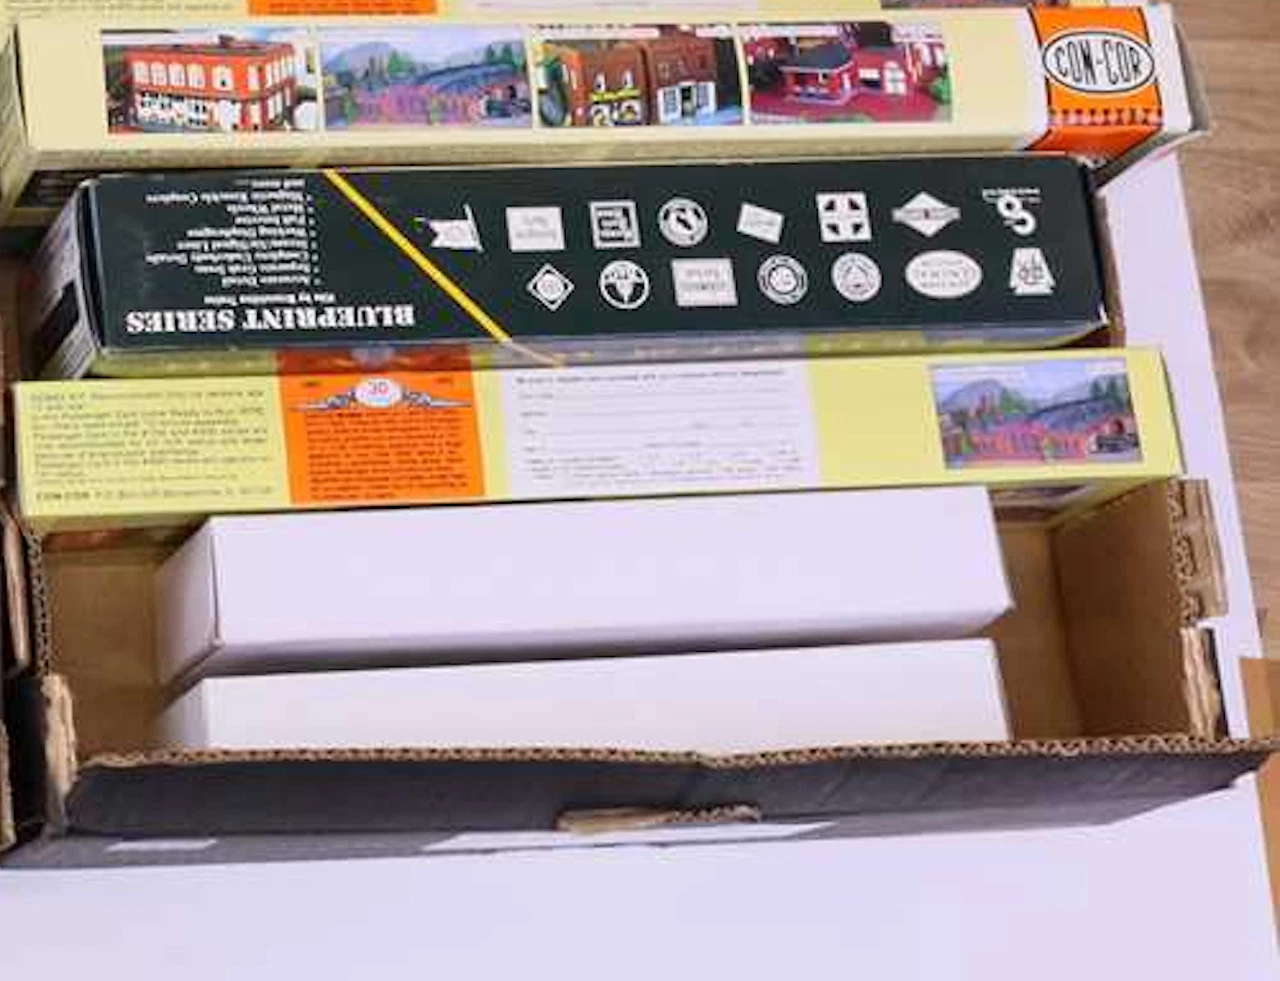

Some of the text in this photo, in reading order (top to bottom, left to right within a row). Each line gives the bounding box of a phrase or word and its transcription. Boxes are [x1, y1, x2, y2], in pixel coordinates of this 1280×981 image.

[1052, 42, 1147, 90] CON-COR
[124, 303, 415, 335] BLUEPRINT SERIES
